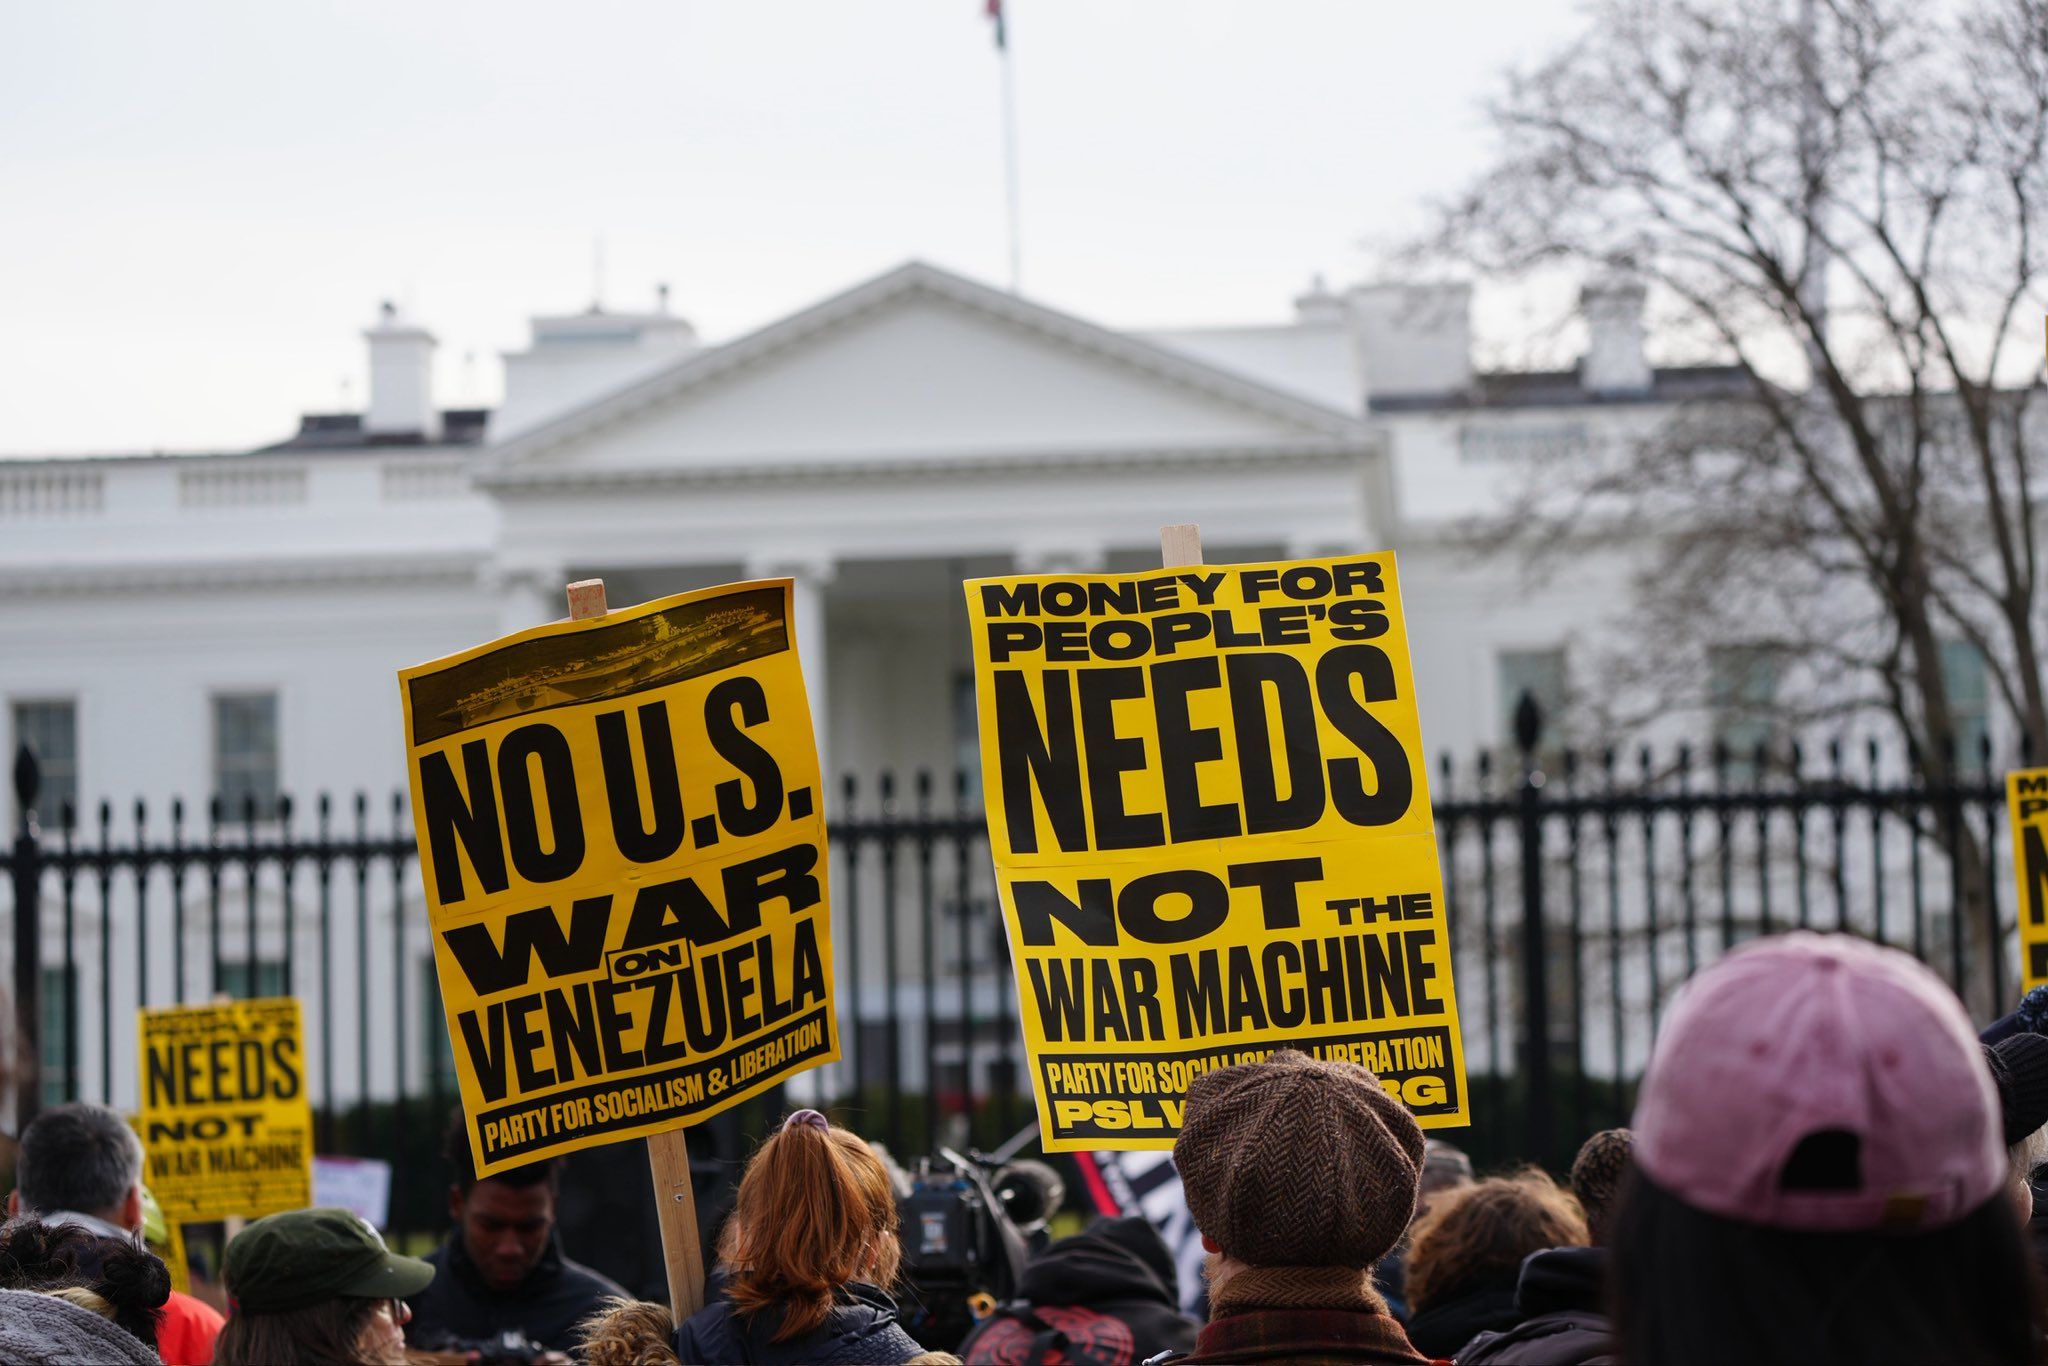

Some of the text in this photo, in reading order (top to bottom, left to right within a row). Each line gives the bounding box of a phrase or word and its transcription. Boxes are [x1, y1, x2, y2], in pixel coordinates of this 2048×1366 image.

[981, 561, 1385, 618] MONEY FOR
[987, 599, 1390, 663] PEOPLE'S
[419, 676, 814, 905] NO U.S.
[993, 644, 1413, 854] NEEDS
[442, 843, 821, 996] WAR
[1010, 857, 1434, 948] NOT THE
[614, 944, 682, 978] ON
[1026, 929, 1445, 1043] WAR MACHINE
[458, 917, 827, 1103] VENEZUELA
[147, 1038, 299, 1109] NEEDS
[484, 1019, 822, 1152] PARTY FOR SOCIALISM & LIBERATION
[1046, 1060, 1115, 1094] PARTY
[1117, 1060, 1158, 1094] FOR
[149, 1115, 264, 1142] NOT
